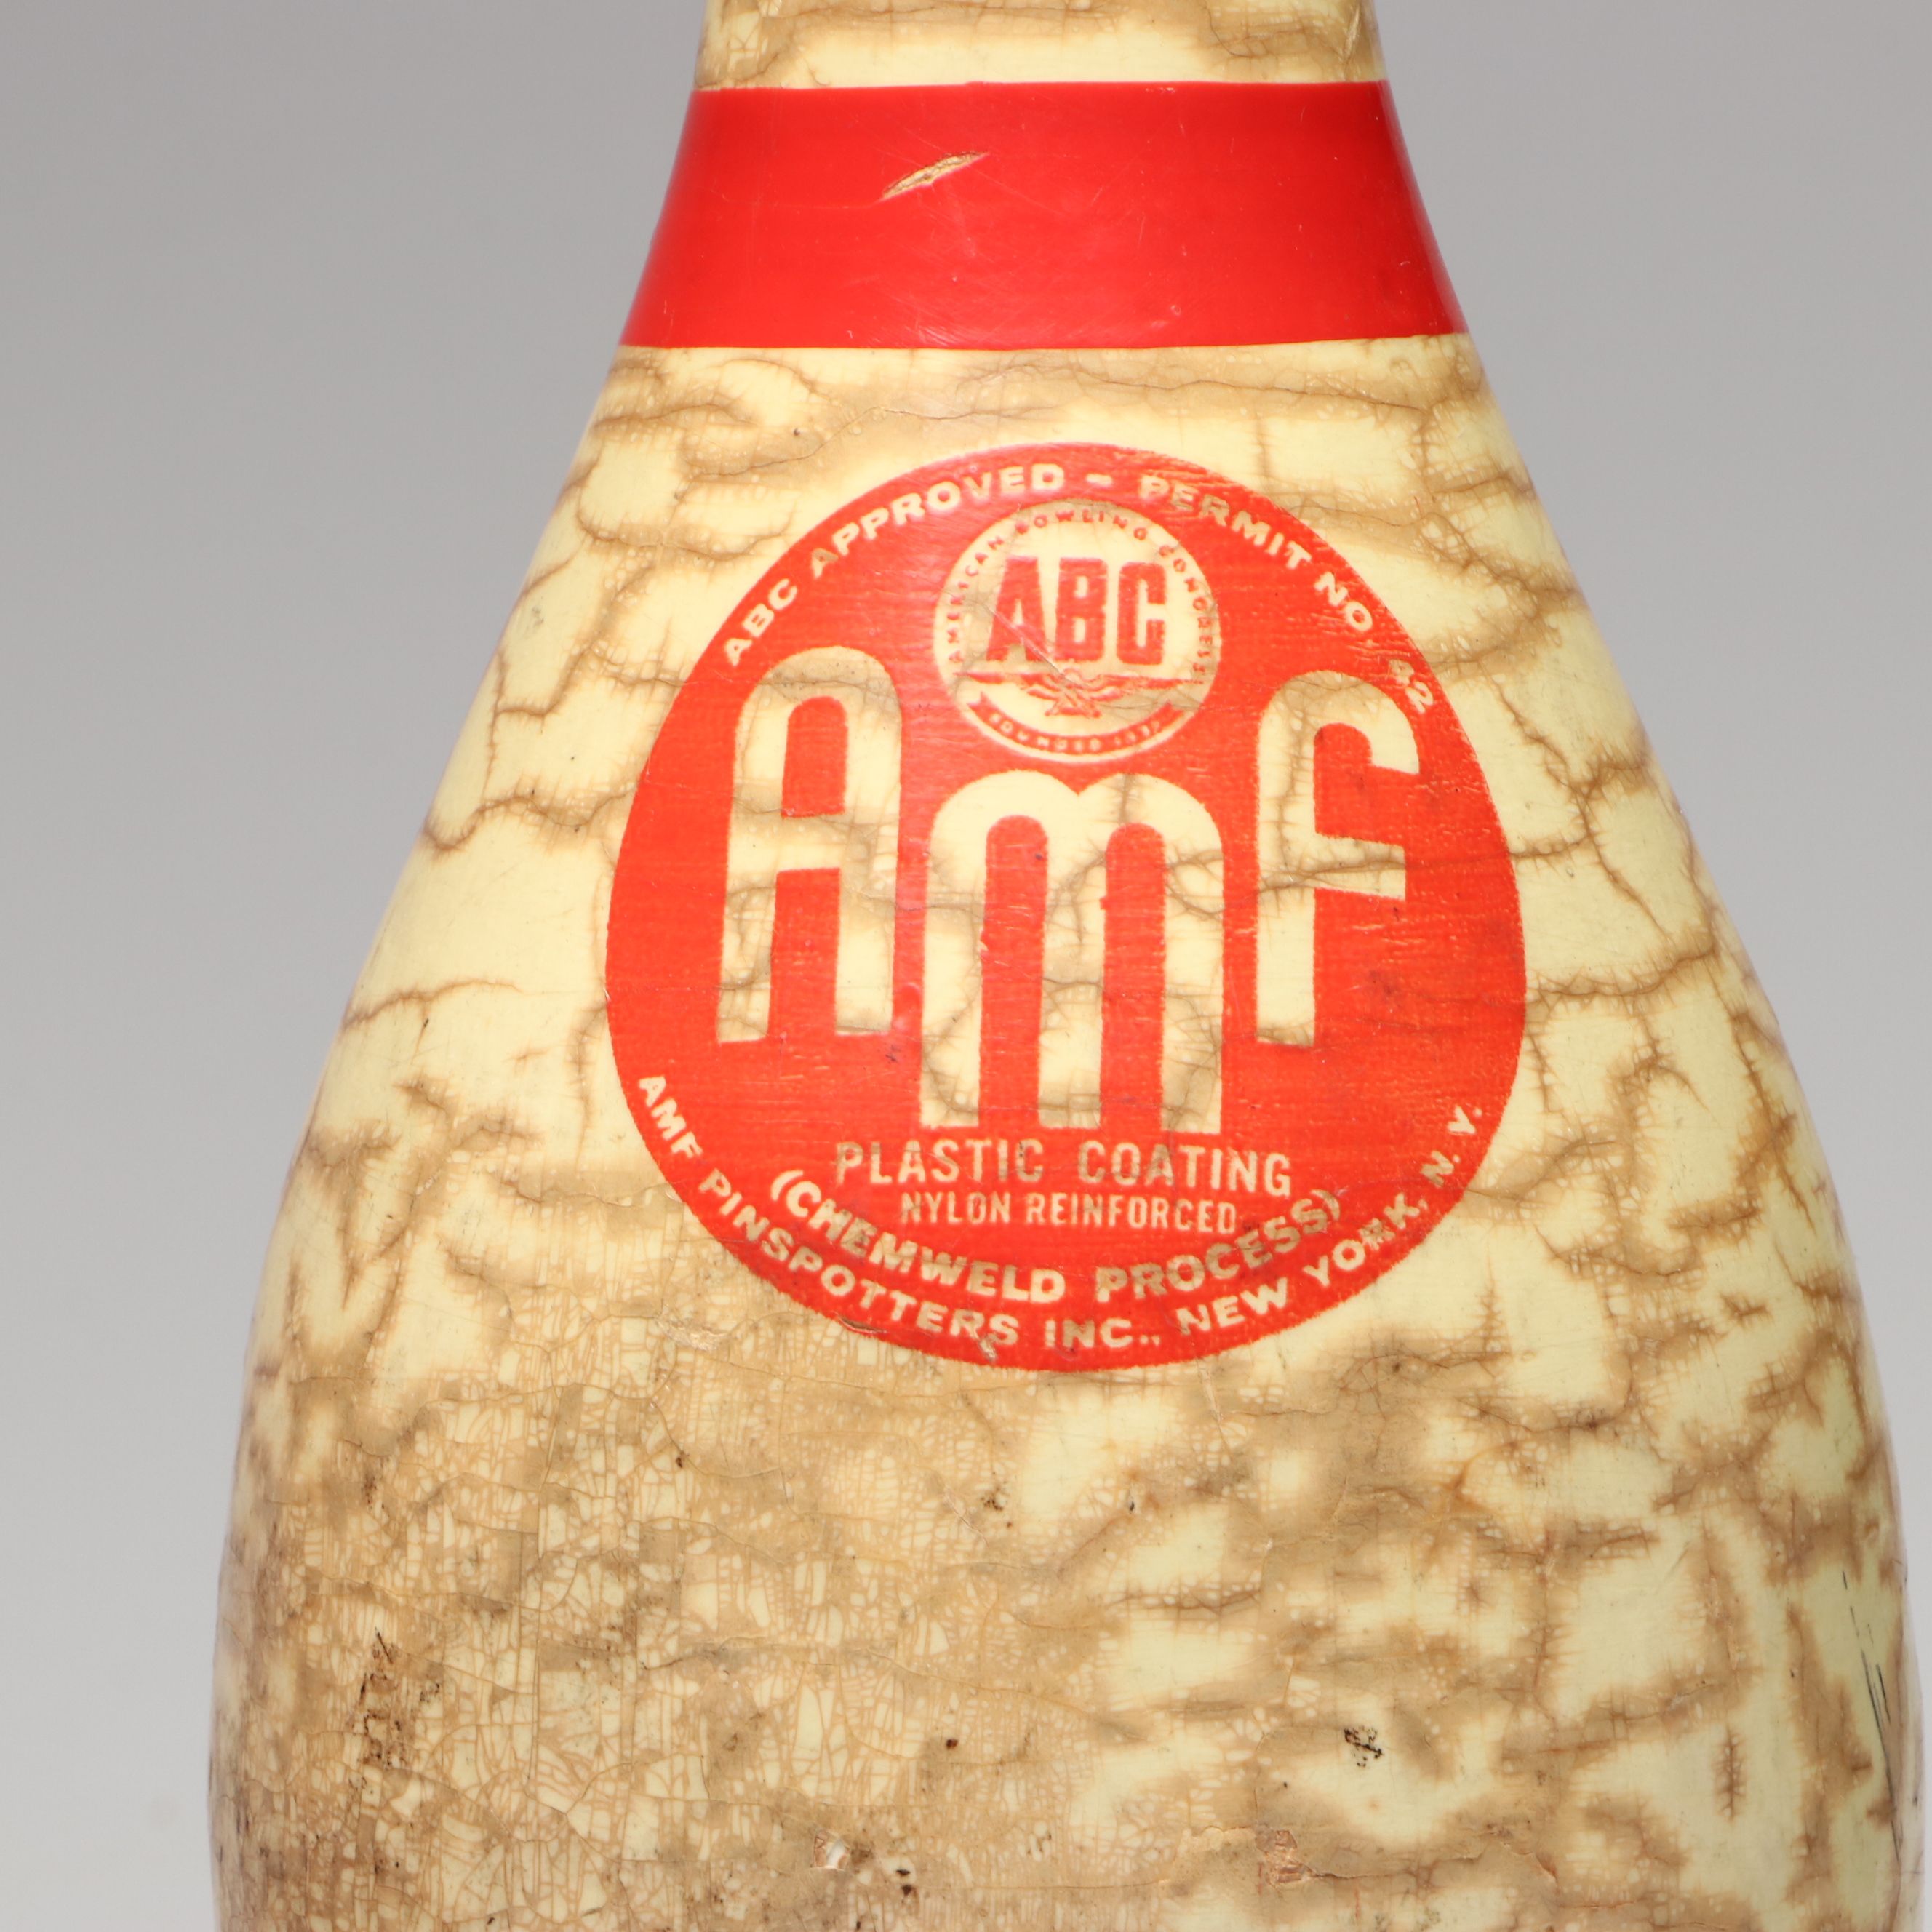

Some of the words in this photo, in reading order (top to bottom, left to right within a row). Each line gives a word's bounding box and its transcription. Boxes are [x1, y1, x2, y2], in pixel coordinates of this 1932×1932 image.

[724, 579, 797, 666] ABC
[810, 463, 1065, 579] APPROVED
[1138, 474, 1312, 570] PERMIT
[1314, 571, 1373, 631] NO
[986, 555, 1166, 665] ABC
[639, 1076, 703, 1160] AMF
[698, 1168, 1018, 1346] PINSPOTTERS
[1175, 1278, 1288, 1336] NEW
[836, 1140, 1043, 1185] PLASTIC
[1077, 1141, 1292, 1197] COATING
[901, 1192, 1010, 1224] NYLON
[1026, 1194, 1236, 1234] REINFORCED
[770, 1170, 1066, 1304] (CHEMWELD
[1095, 1189, 1340, 1303] PROCESS)
